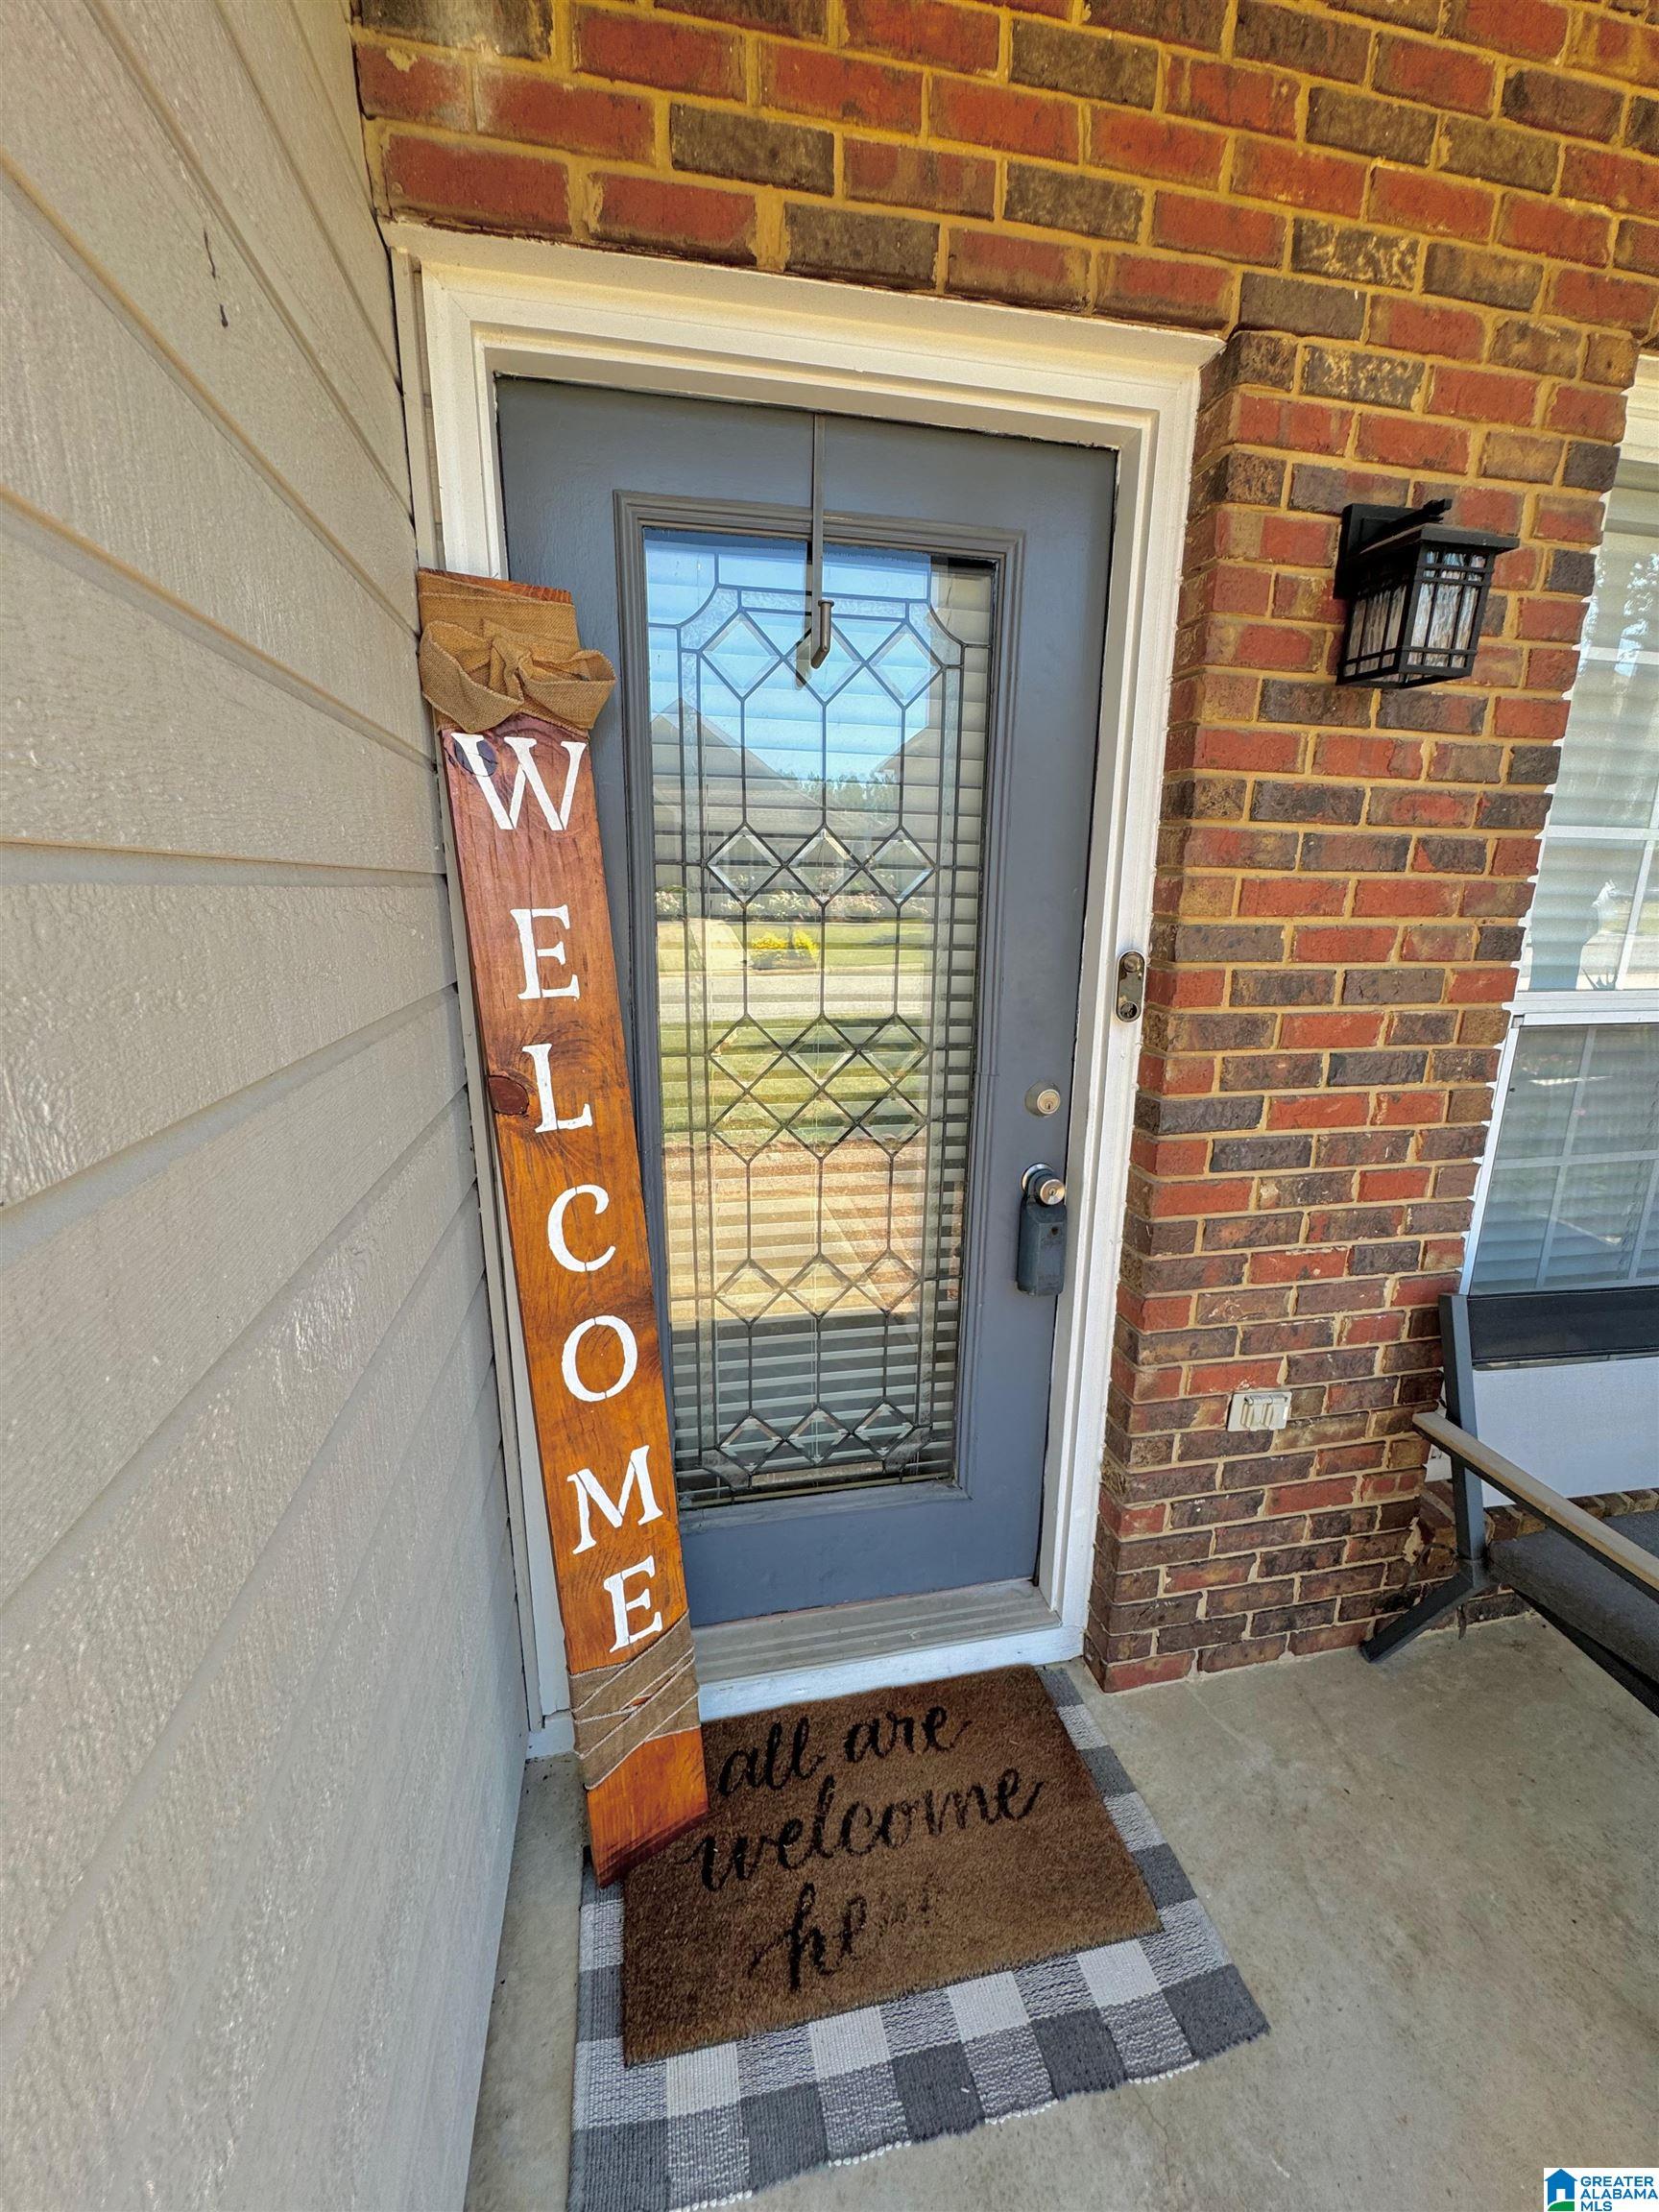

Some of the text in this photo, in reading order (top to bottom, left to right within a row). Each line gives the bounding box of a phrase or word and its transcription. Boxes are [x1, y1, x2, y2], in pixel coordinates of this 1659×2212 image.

[450, 733, 664, 1653] WELCOME
[716, 1705, 971, 1797] all are
[680, 1767, 1045, 1890] welcome
